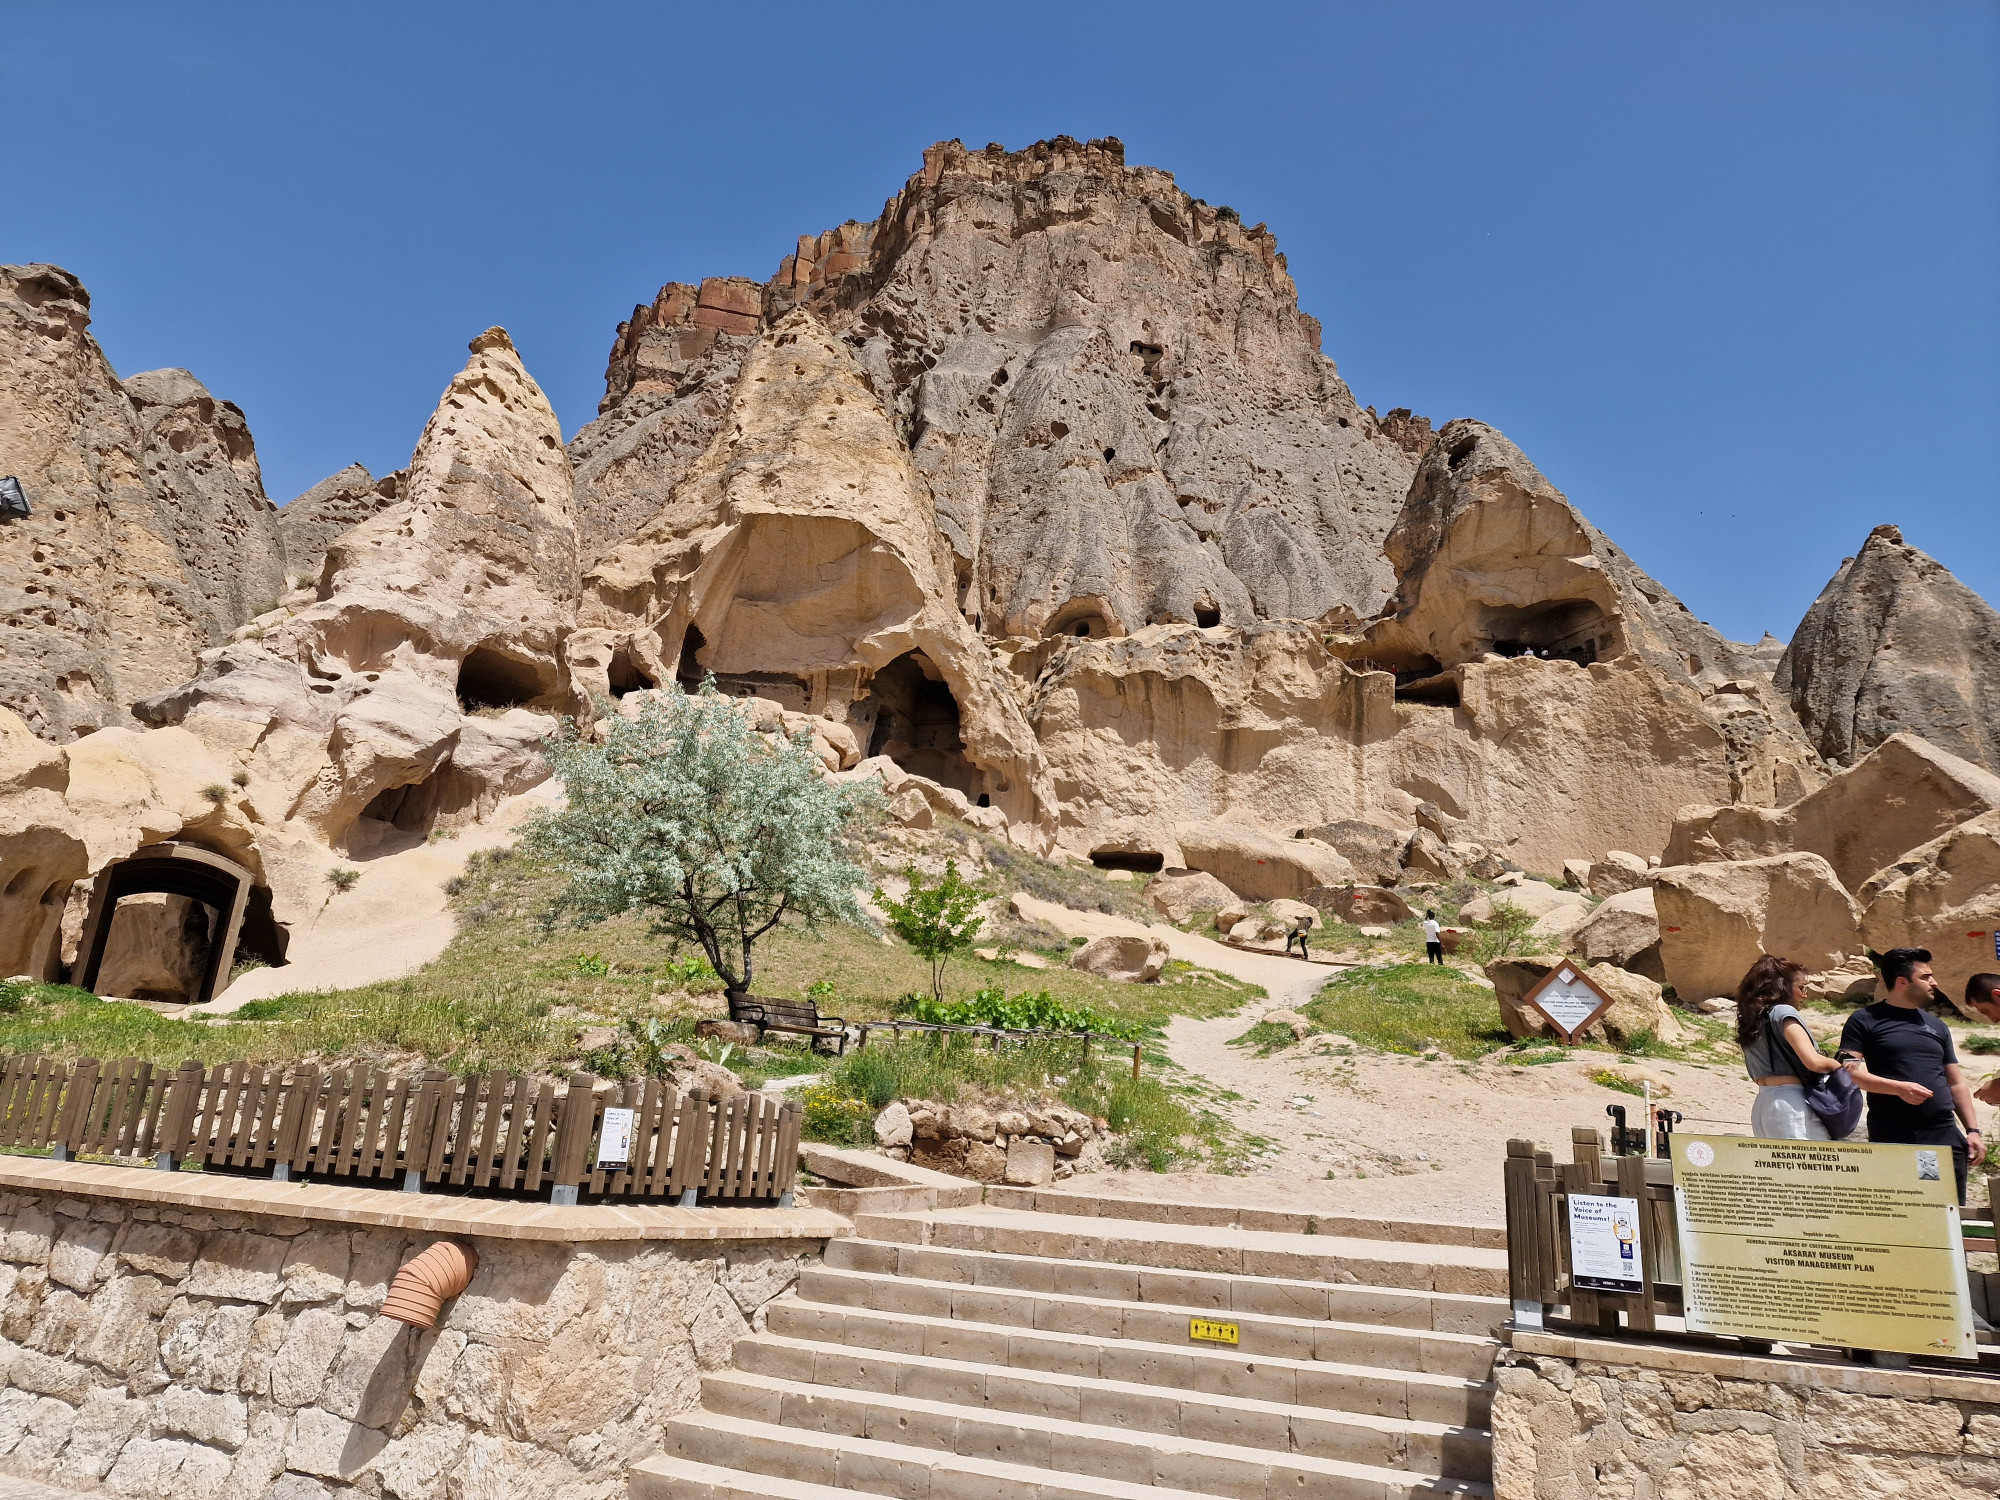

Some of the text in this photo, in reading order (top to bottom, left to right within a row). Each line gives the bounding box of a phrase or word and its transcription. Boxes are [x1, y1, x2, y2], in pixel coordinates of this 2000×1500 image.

[1771, 1152, 1839, 1161] AKSARAY MÜZESİ
[1754, 1159, 1859, 1172] ZİYARETÇİ YÖNETİM PLANI
[1573, 1199, 1594, 1207] Listen
[1573, 1206, 1592, 1214] Voice
[1573, 1213, 1610, 1222] Museums!
[1783, 1249, 1854, 1260] AKSARAY MUSEUM
[1765, 1257, 1874, 1272] VISITOR MANAGEMENT PLAN
